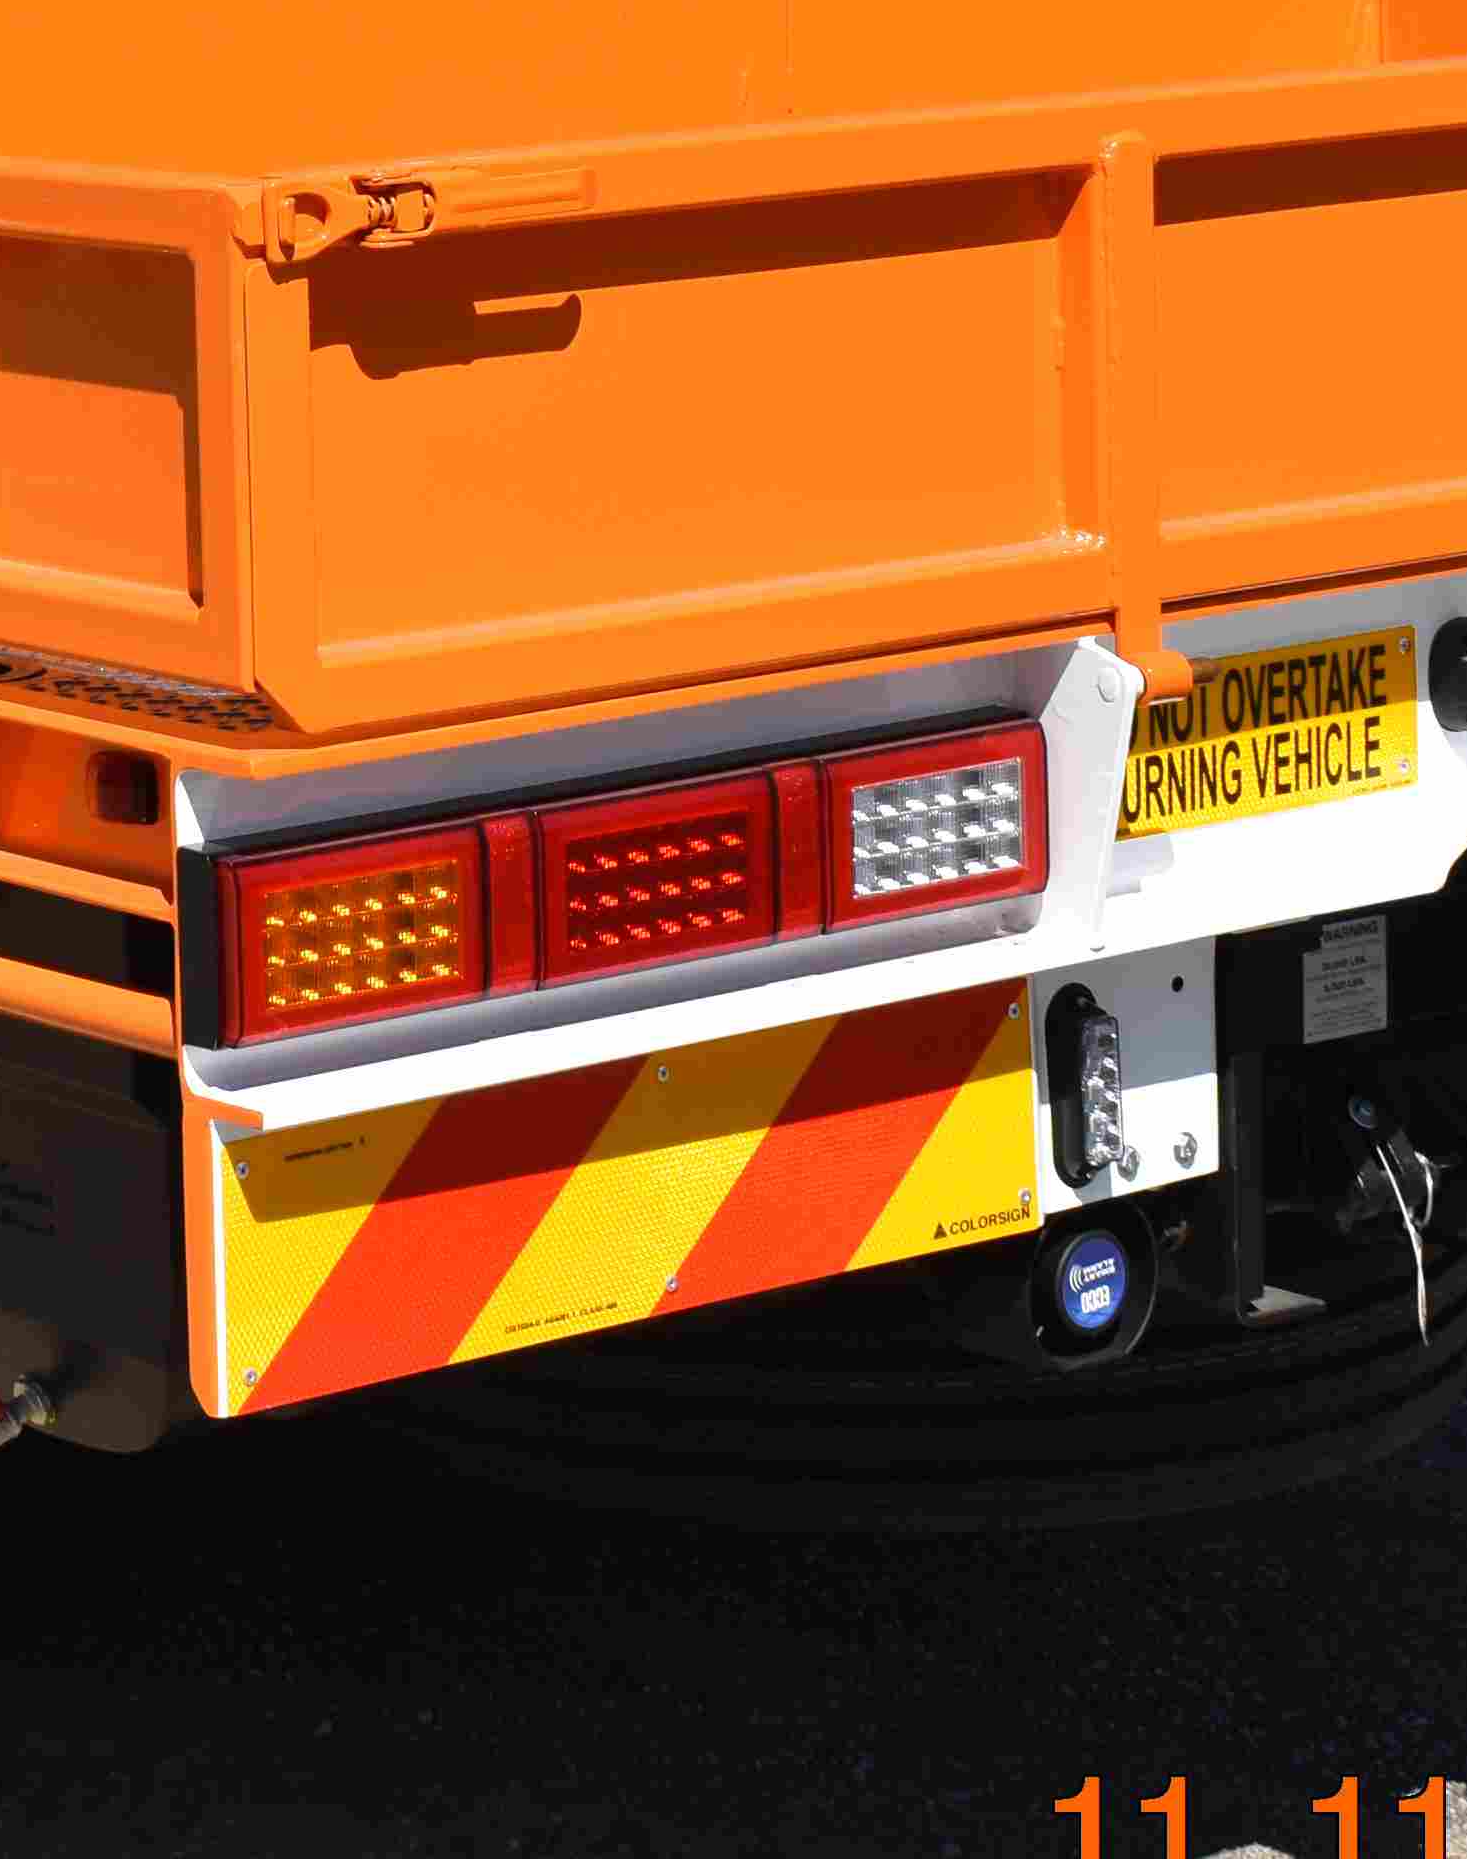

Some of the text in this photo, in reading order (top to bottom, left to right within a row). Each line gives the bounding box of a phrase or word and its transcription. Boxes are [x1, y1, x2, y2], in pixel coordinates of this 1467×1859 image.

[1223, 643, 1387, 734] OVERTAKE
[1123, 715, 1381, 823] URNING VEHICLE
[949, 1203, 1031, 1235] COLORSIGN
